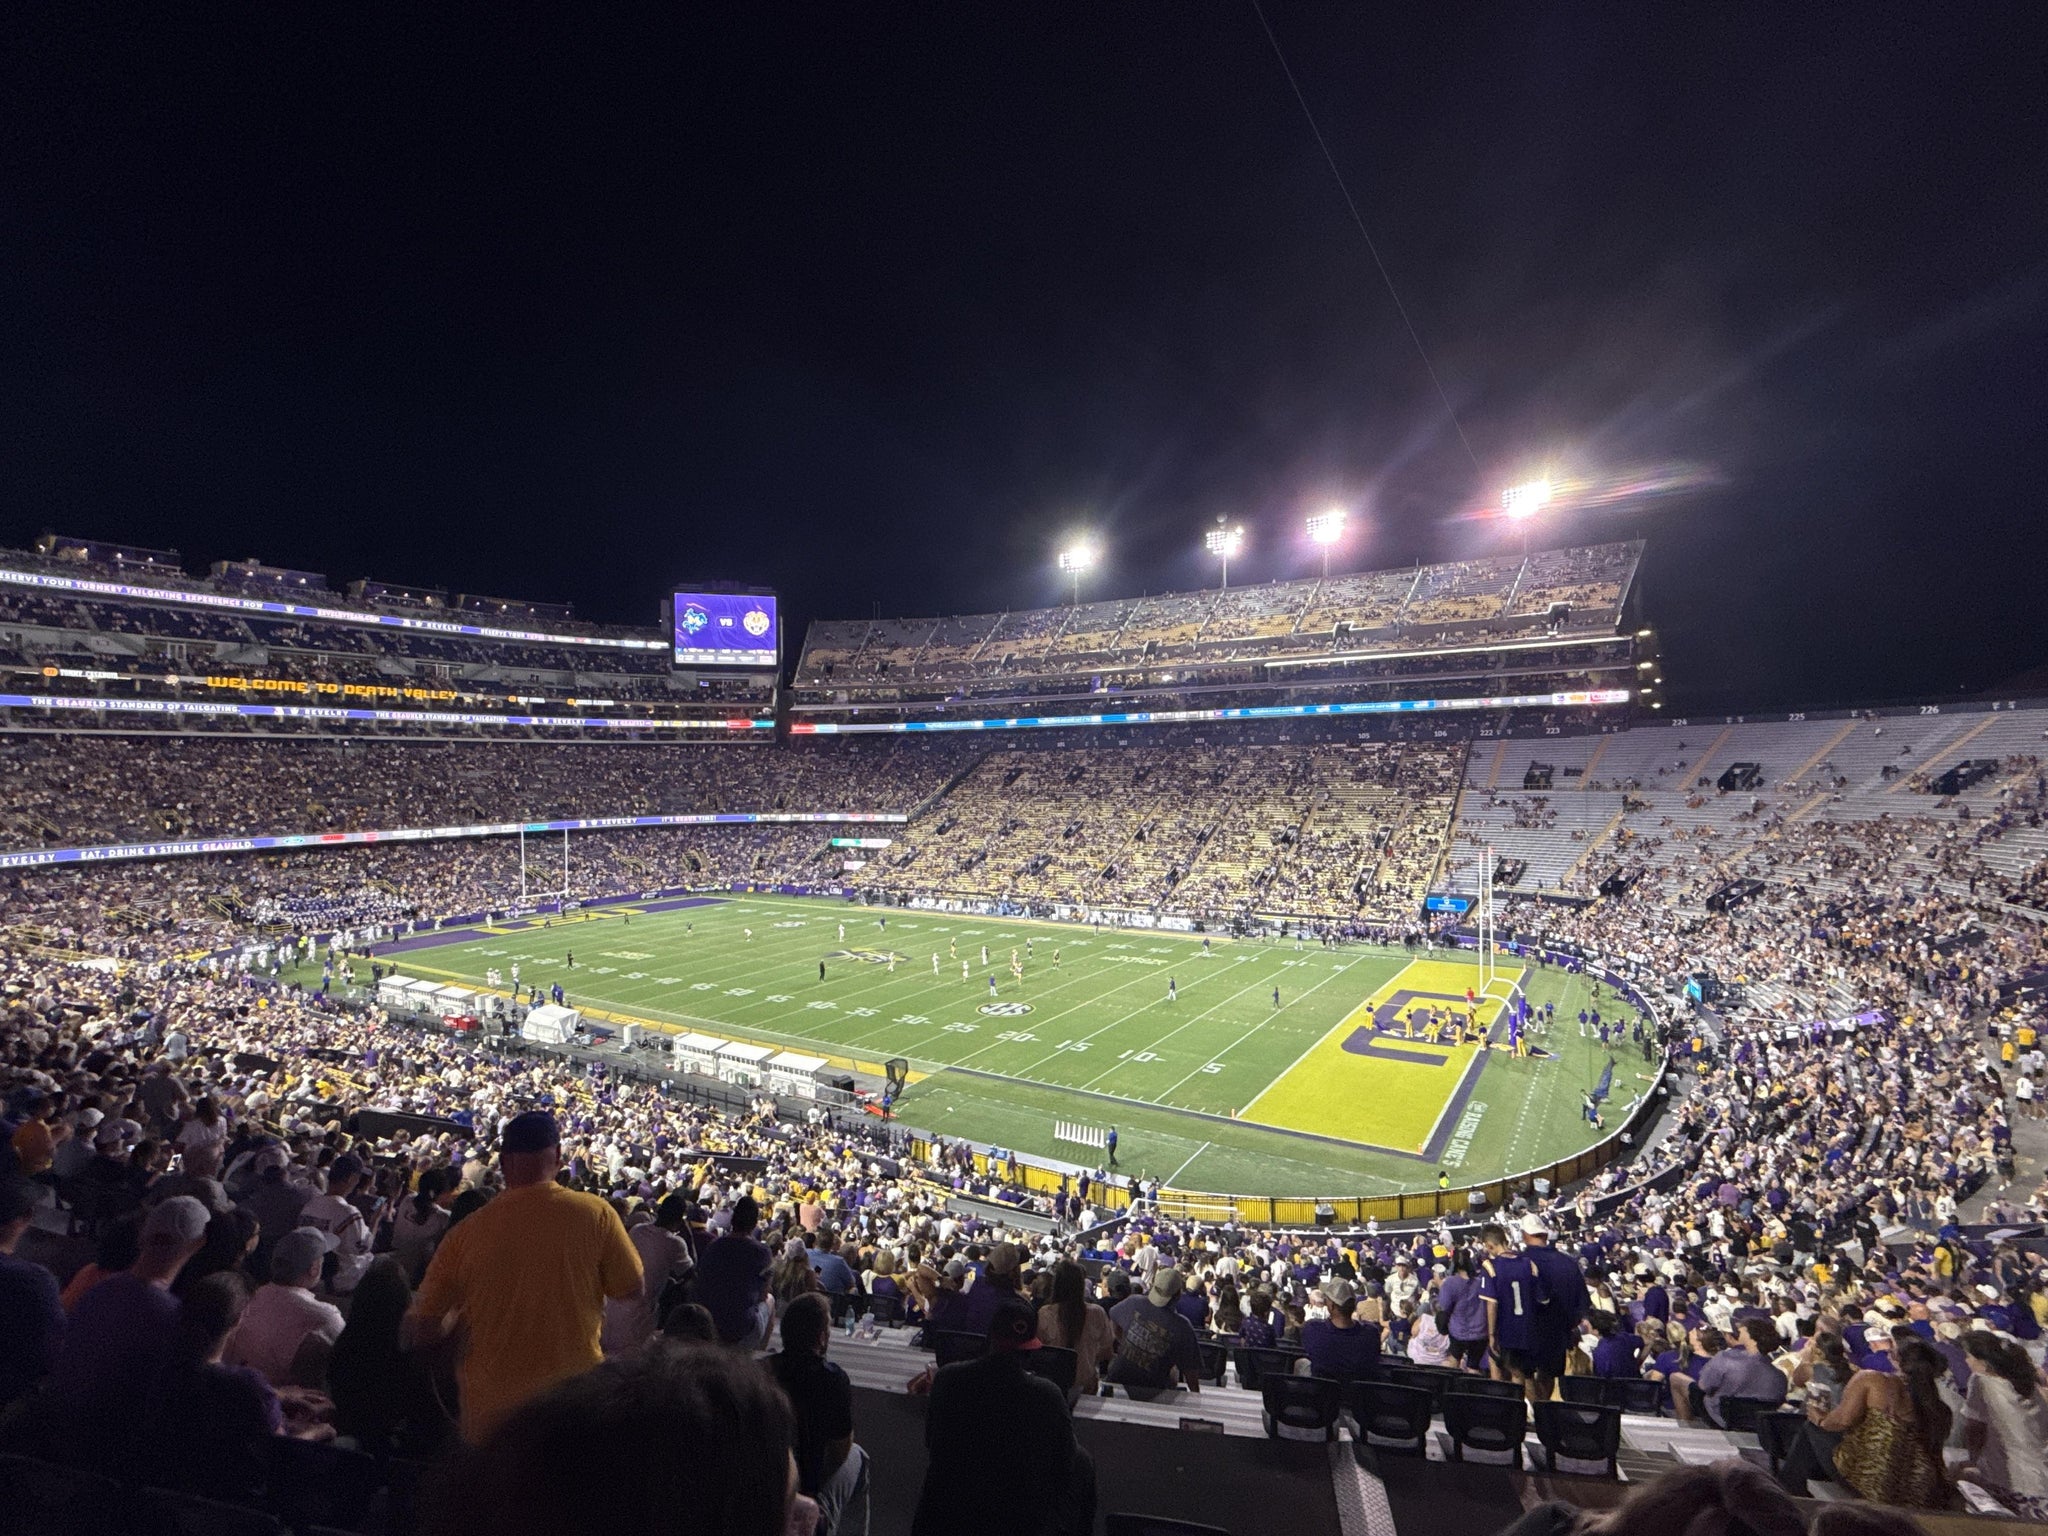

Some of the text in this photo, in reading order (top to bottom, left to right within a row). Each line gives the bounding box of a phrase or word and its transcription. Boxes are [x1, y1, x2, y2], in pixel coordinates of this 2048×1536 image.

[42, 578, 72, 587] YOUR
[76, 581, 123, 593] TURNKEY
[127, 586, 182, 600] TAILGATING
[186, 594, 241, 607] EXPERIENCE
[243, 600, 264, 608] NOW
[720, 618, 733, 627] VS
[207, 676, 457, 699] WELCOME TO DEATH VALLEY
[56, 698, 106, 707] GEAUXLD
[109, 701, 163, 709] STANDARD
[183, 704, 241, 712] TAILGATING.
[1920, 706, 1939, 715] 226
[80, 851, 105, 859] EAT,
[109, 847, 145, 857] DRINK
[160, 844, 198, 854] STRIKE
[202, 841, 255, 851] GEAUXLD.
[2, 854, 55, 866] EVELRY
[845, 1007, 881, 1017] 35
[892, 1014, 928, 1025] 30
[941, 1022, 980, 1033] 25
[995, 1031, 1036, 1043] 20
[1055, 1040, 1094, 1052] 15
[1118, 1050, 1158, 1062] 10
[1202, 1062, 1226, 1074] 5
[1441, 1111, 1482, 1168] RAISING CANE'S
[1940, 1202, 1946, 1212] 3
[1511, 1281, 1523, 1315] 1
